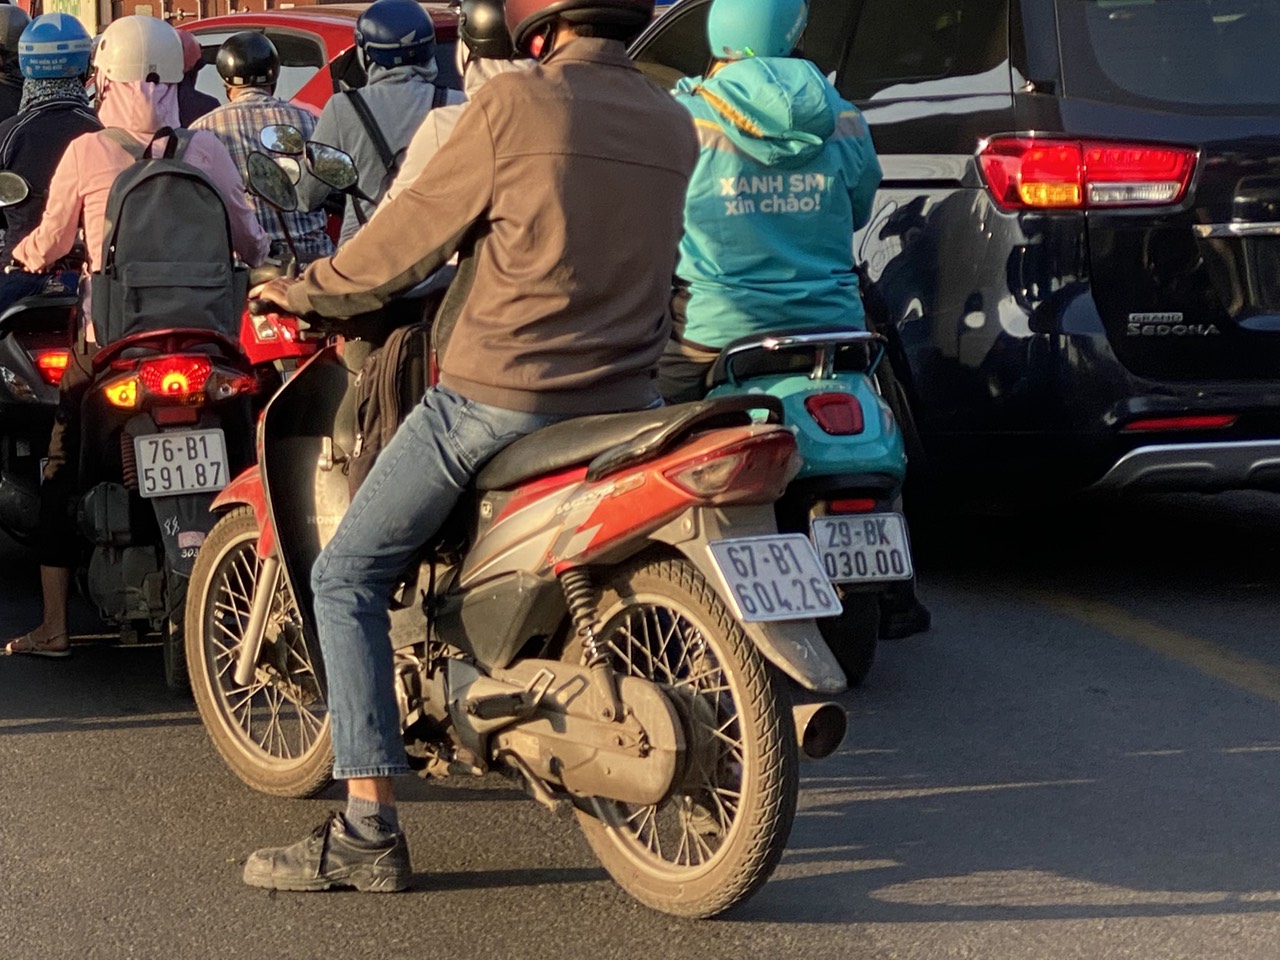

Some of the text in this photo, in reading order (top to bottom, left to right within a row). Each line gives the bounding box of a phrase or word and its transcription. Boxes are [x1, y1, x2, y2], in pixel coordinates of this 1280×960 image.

[720, 173, 825, 197] XANH SM
[725, 193, 821, 216] xin chào!
[148, 435, 209, 464] 76-B1
[144, 461, 221, 492] 591.87
[825, 519, 891, 548] 29-BK
[727, 542, 804, 578] 67-B1
[824, 549, 905, 578] 030.00
[735, 577, 833, 615] 604.26
